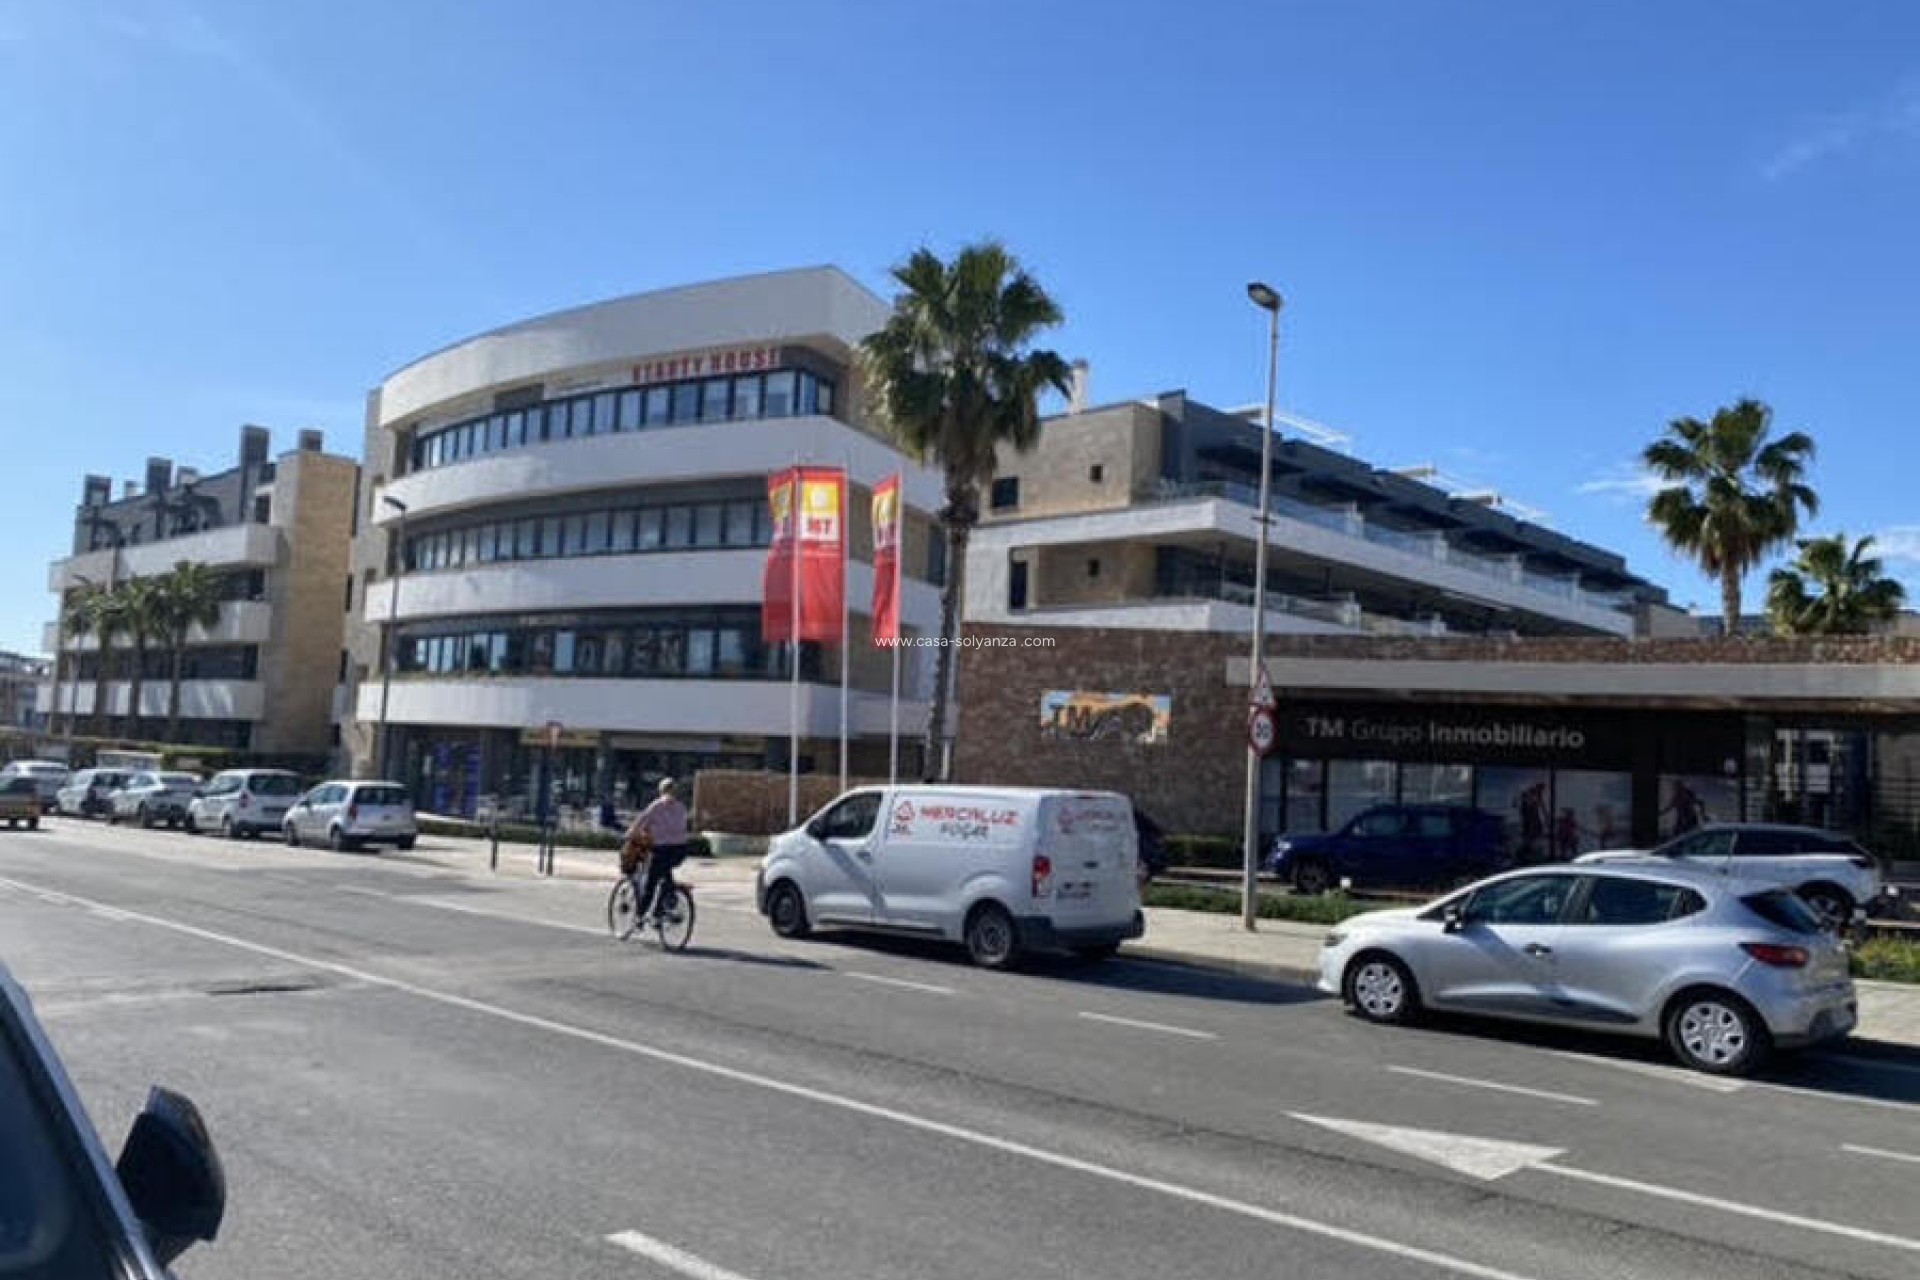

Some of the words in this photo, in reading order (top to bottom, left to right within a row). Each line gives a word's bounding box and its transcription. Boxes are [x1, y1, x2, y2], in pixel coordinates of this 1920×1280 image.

[1305, 716, 1345, 738] TM
[1351, 719, 1423, 745] Grupo
[1429, 720, 1586, 749] Inmobiliario
